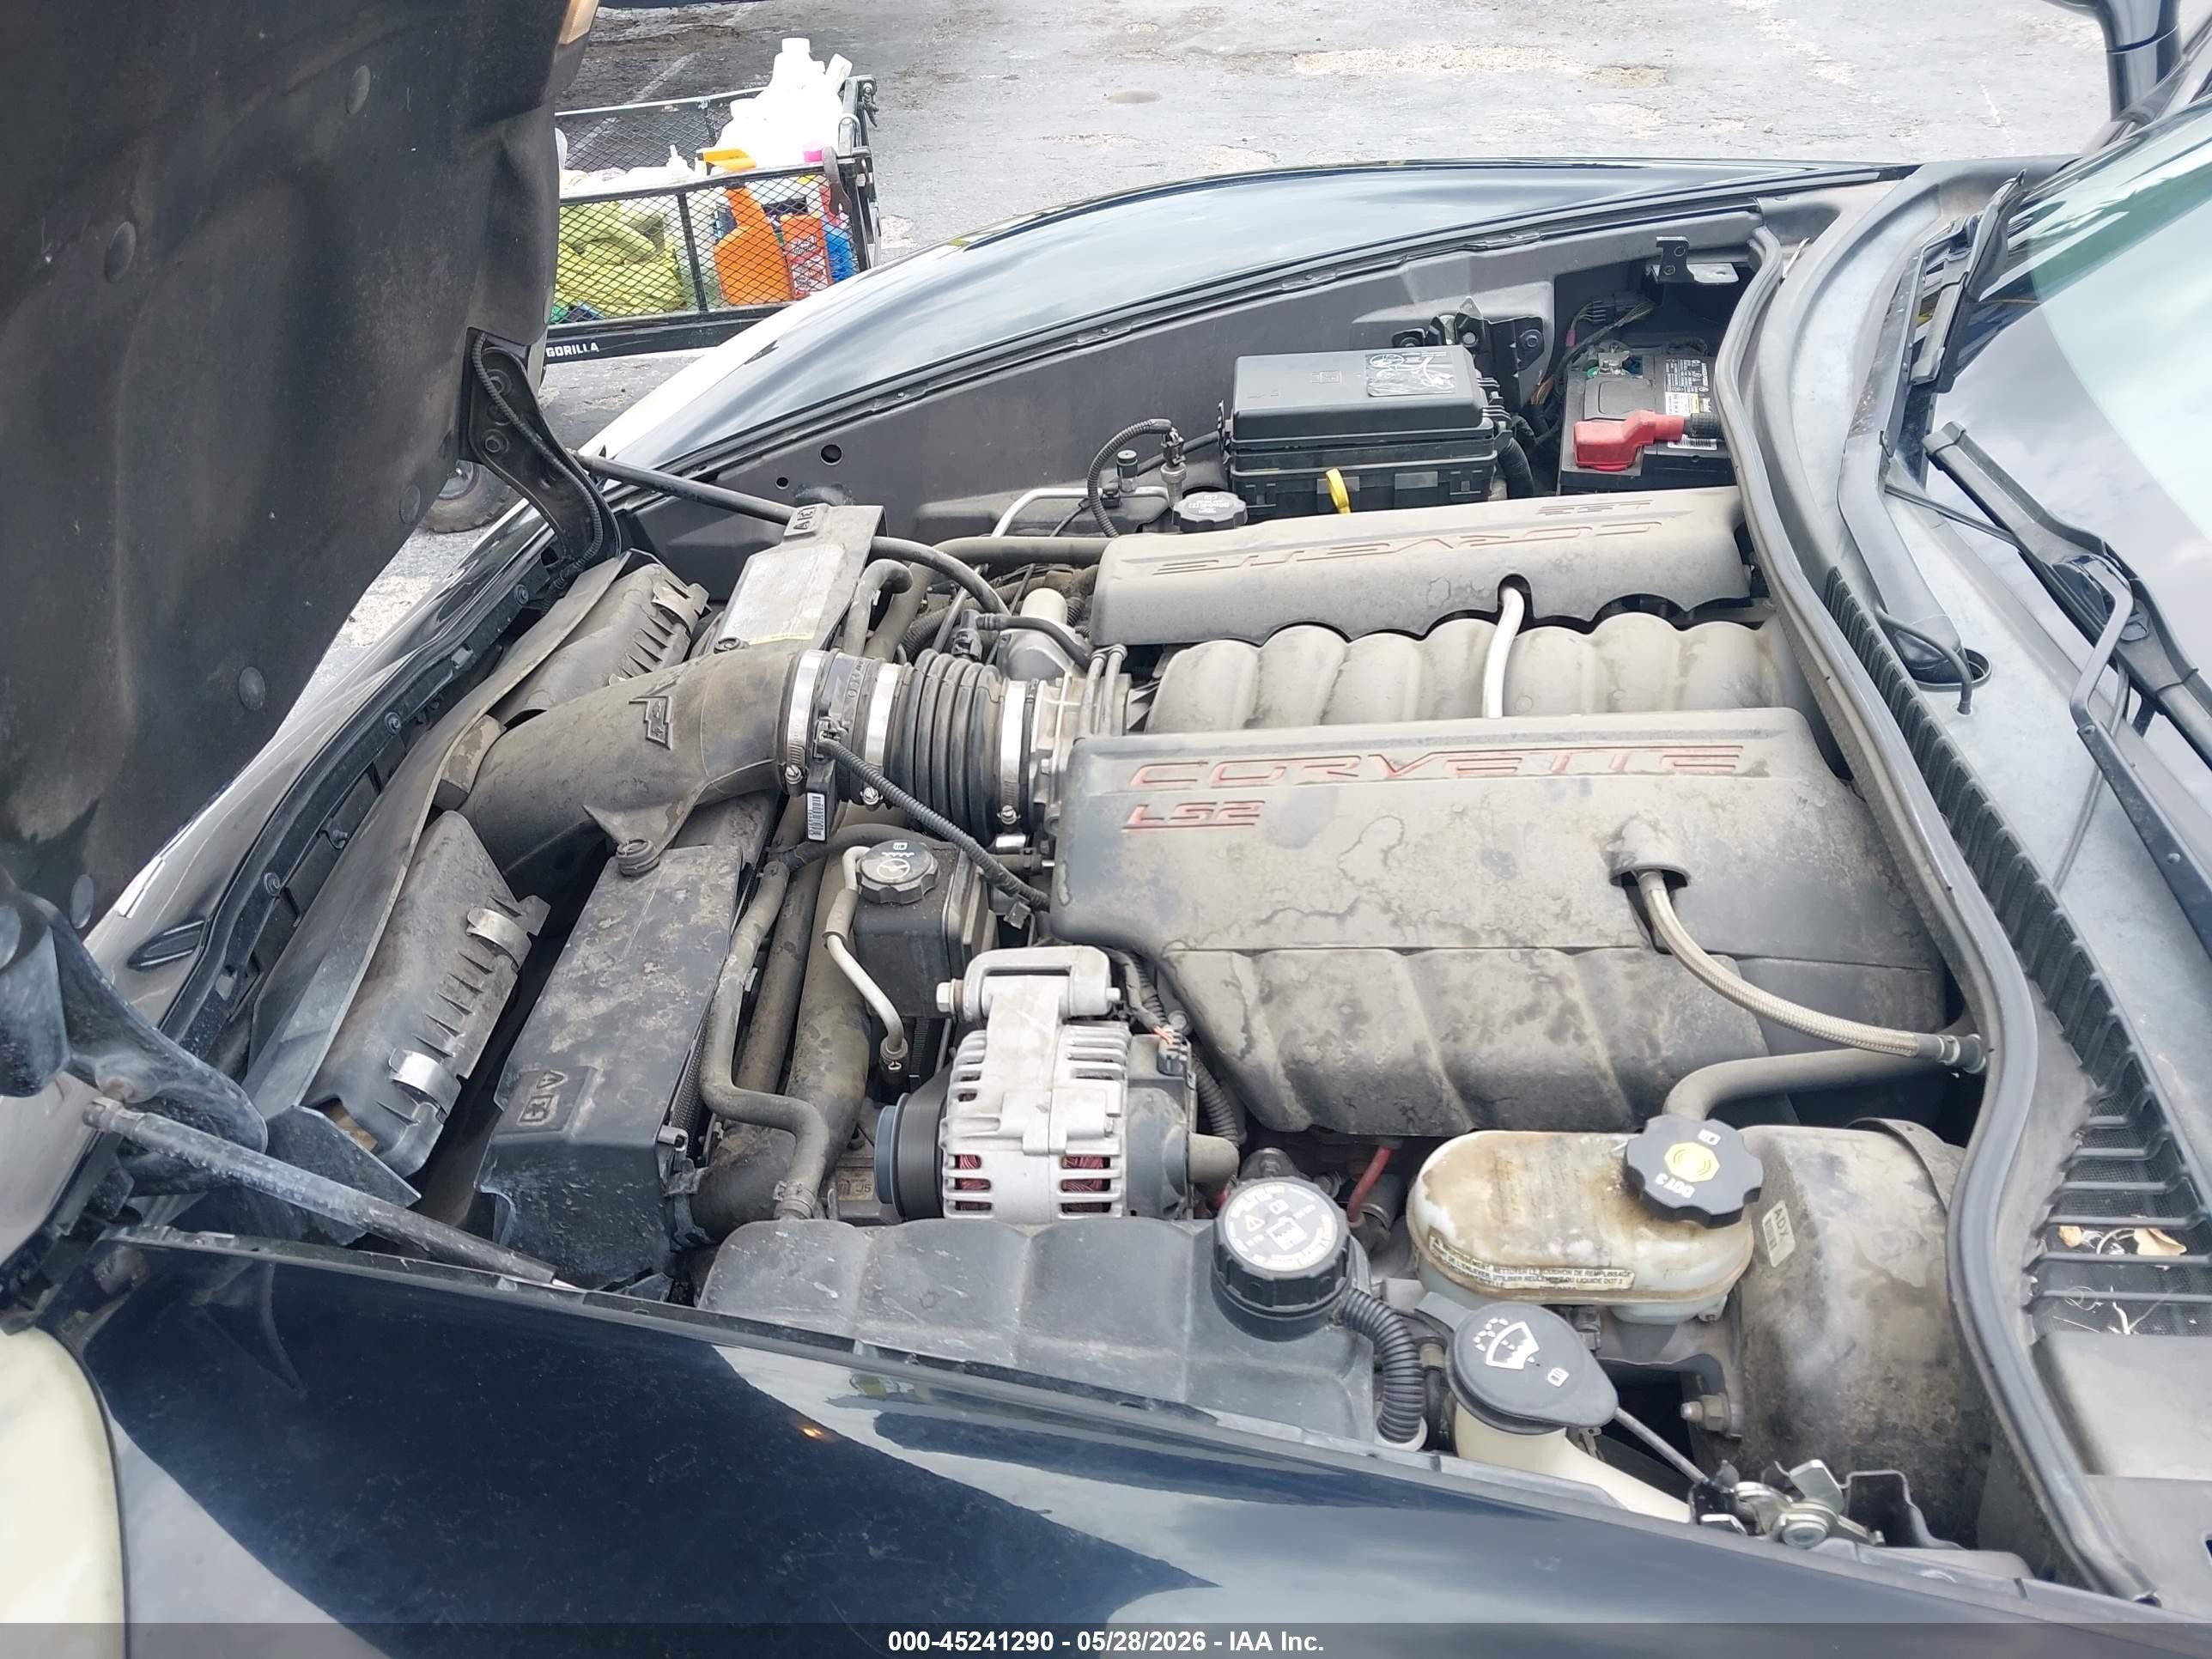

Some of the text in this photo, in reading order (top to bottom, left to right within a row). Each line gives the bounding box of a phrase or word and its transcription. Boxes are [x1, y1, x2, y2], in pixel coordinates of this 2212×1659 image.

[545, 342, 600, 358] GORILLA
[1130, 744, 1744, 789] CORVETTE
[1122, 799, 1266, 828] LS2
[1655, 1172, 1696, 1199] DOT 3
